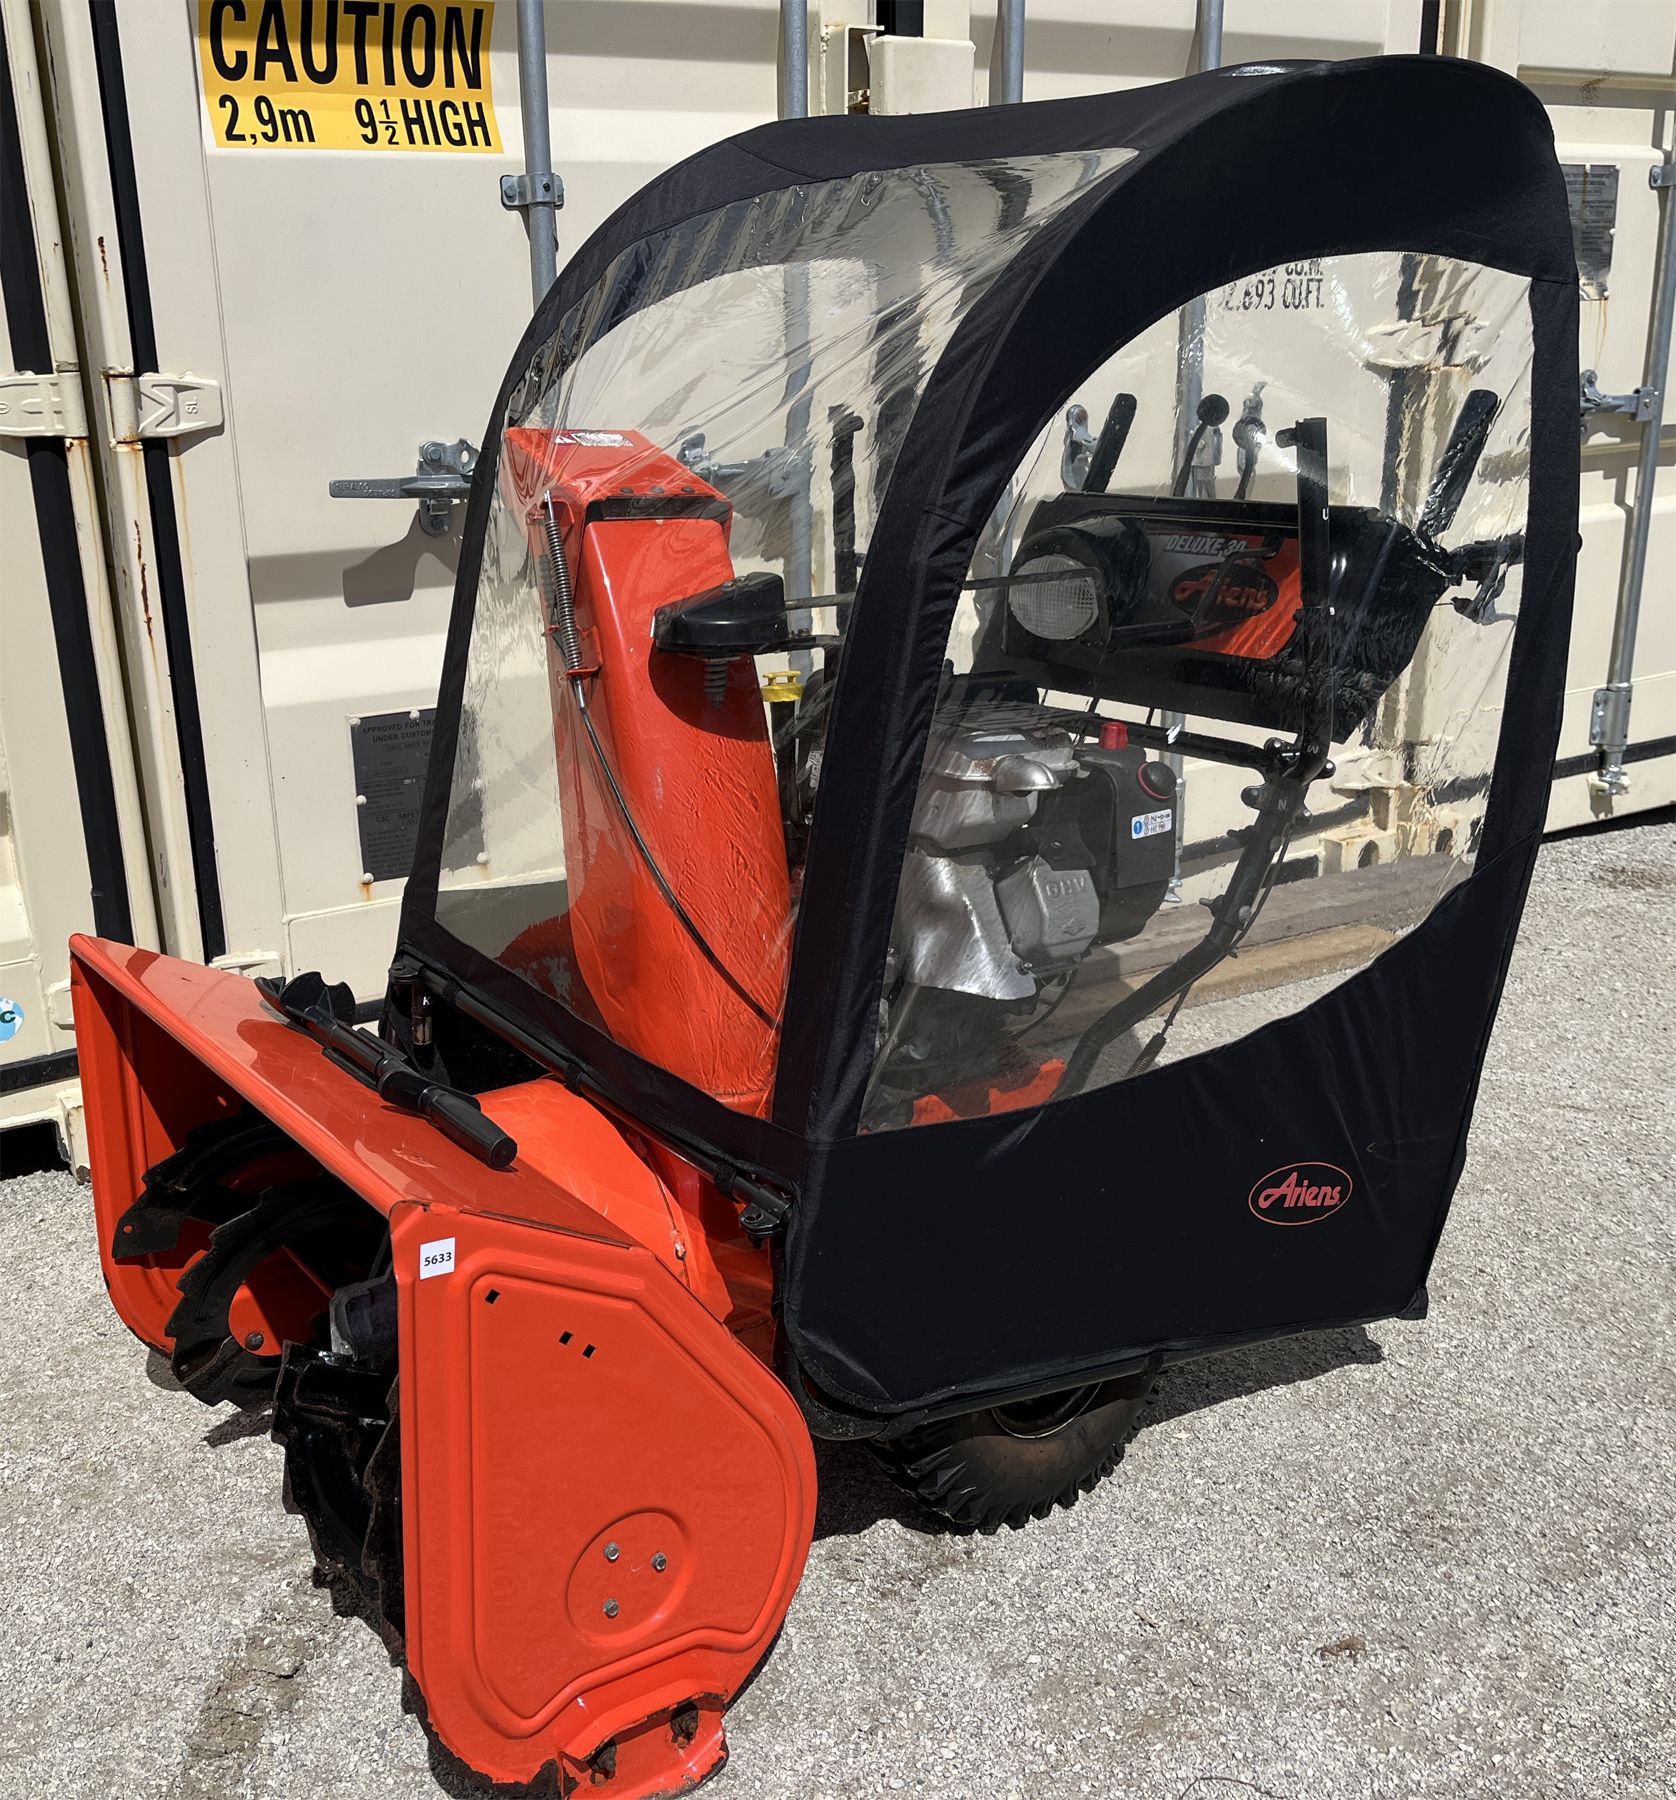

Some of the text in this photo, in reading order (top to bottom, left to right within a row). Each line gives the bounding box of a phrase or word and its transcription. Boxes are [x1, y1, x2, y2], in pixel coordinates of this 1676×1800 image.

[209, 0, 484, 89] CAUTION
[219, 94, 316, 146] 2,9m
[1166, 534, 1224, 555] DELUXE
[362, 723, 402, 735] APPROVED
[405, 721, 420, 729] FOR
[372, 733, 399, 743] UNDER
[1258, 1171, 1341, 1209] Ariens
[424, 1252, 452, 1267] 5633
